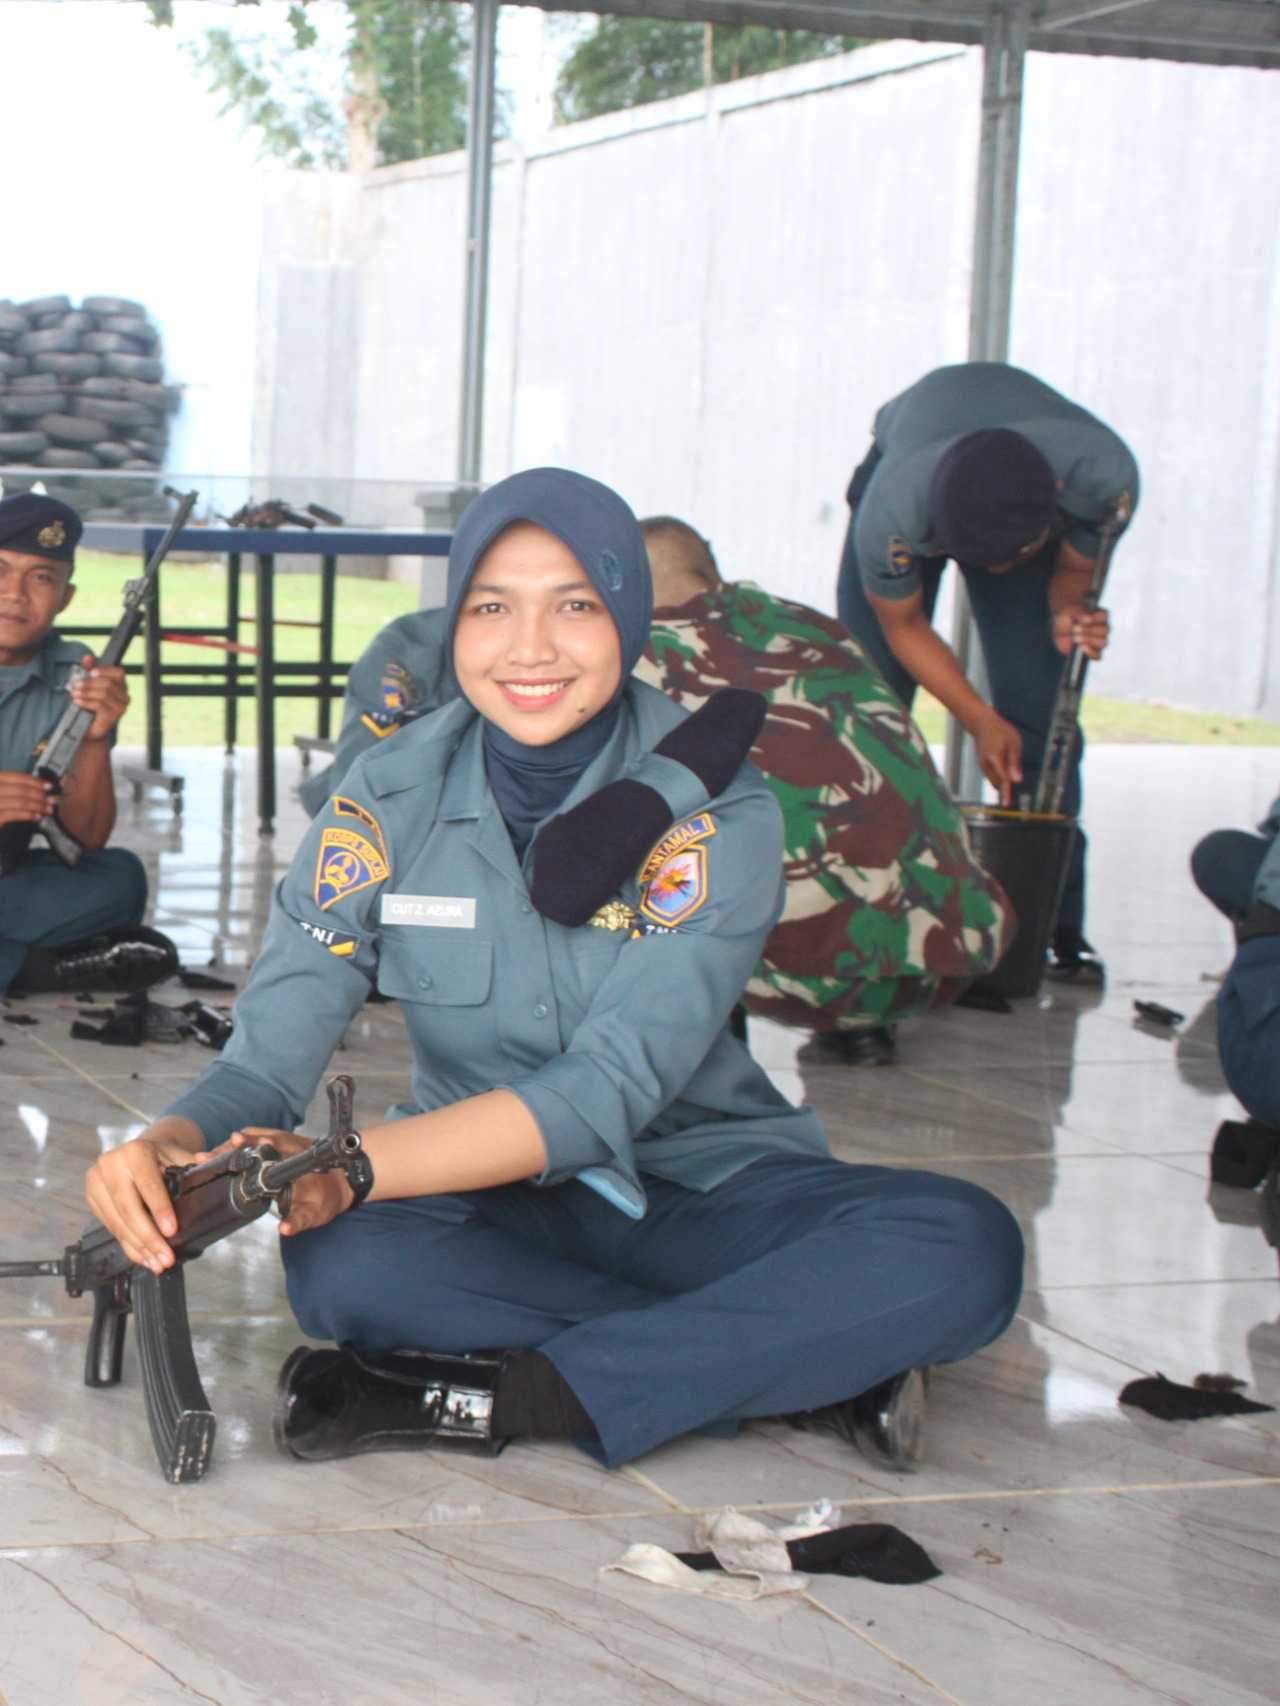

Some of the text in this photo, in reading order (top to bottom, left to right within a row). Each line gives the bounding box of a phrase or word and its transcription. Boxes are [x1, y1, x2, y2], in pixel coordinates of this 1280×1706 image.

[326, 831, 360, 848] KORPS
[392, 902, 414, 915] CUT
[426, 904, 463, 917] AZURA
